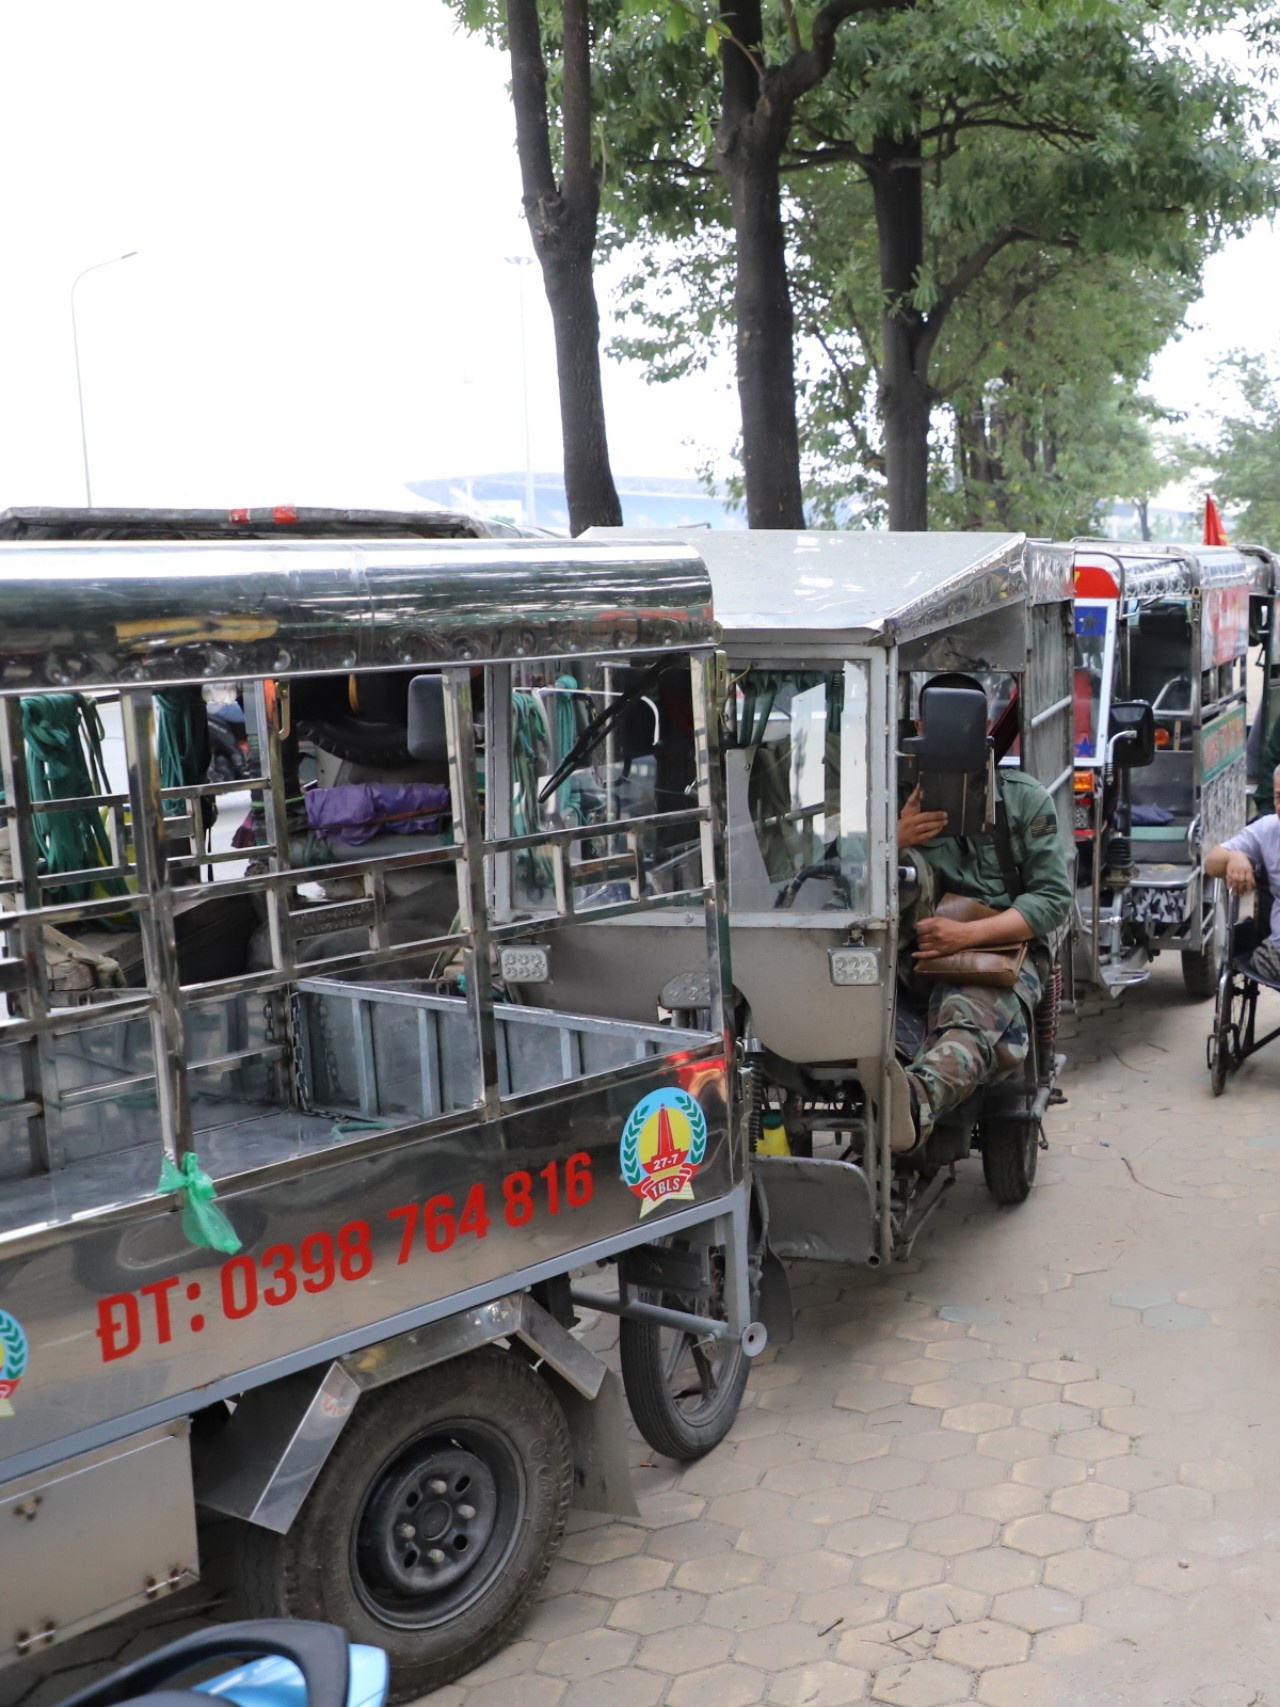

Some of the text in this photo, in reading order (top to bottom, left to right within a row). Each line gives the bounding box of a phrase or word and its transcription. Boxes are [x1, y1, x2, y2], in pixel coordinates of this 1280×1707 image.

[653, 1153, 679, 1171] 27-7
[650, 1177, 681, 1198] TBLS
[96, 1151, 594, 1363] ĐT: 0398 764 816
